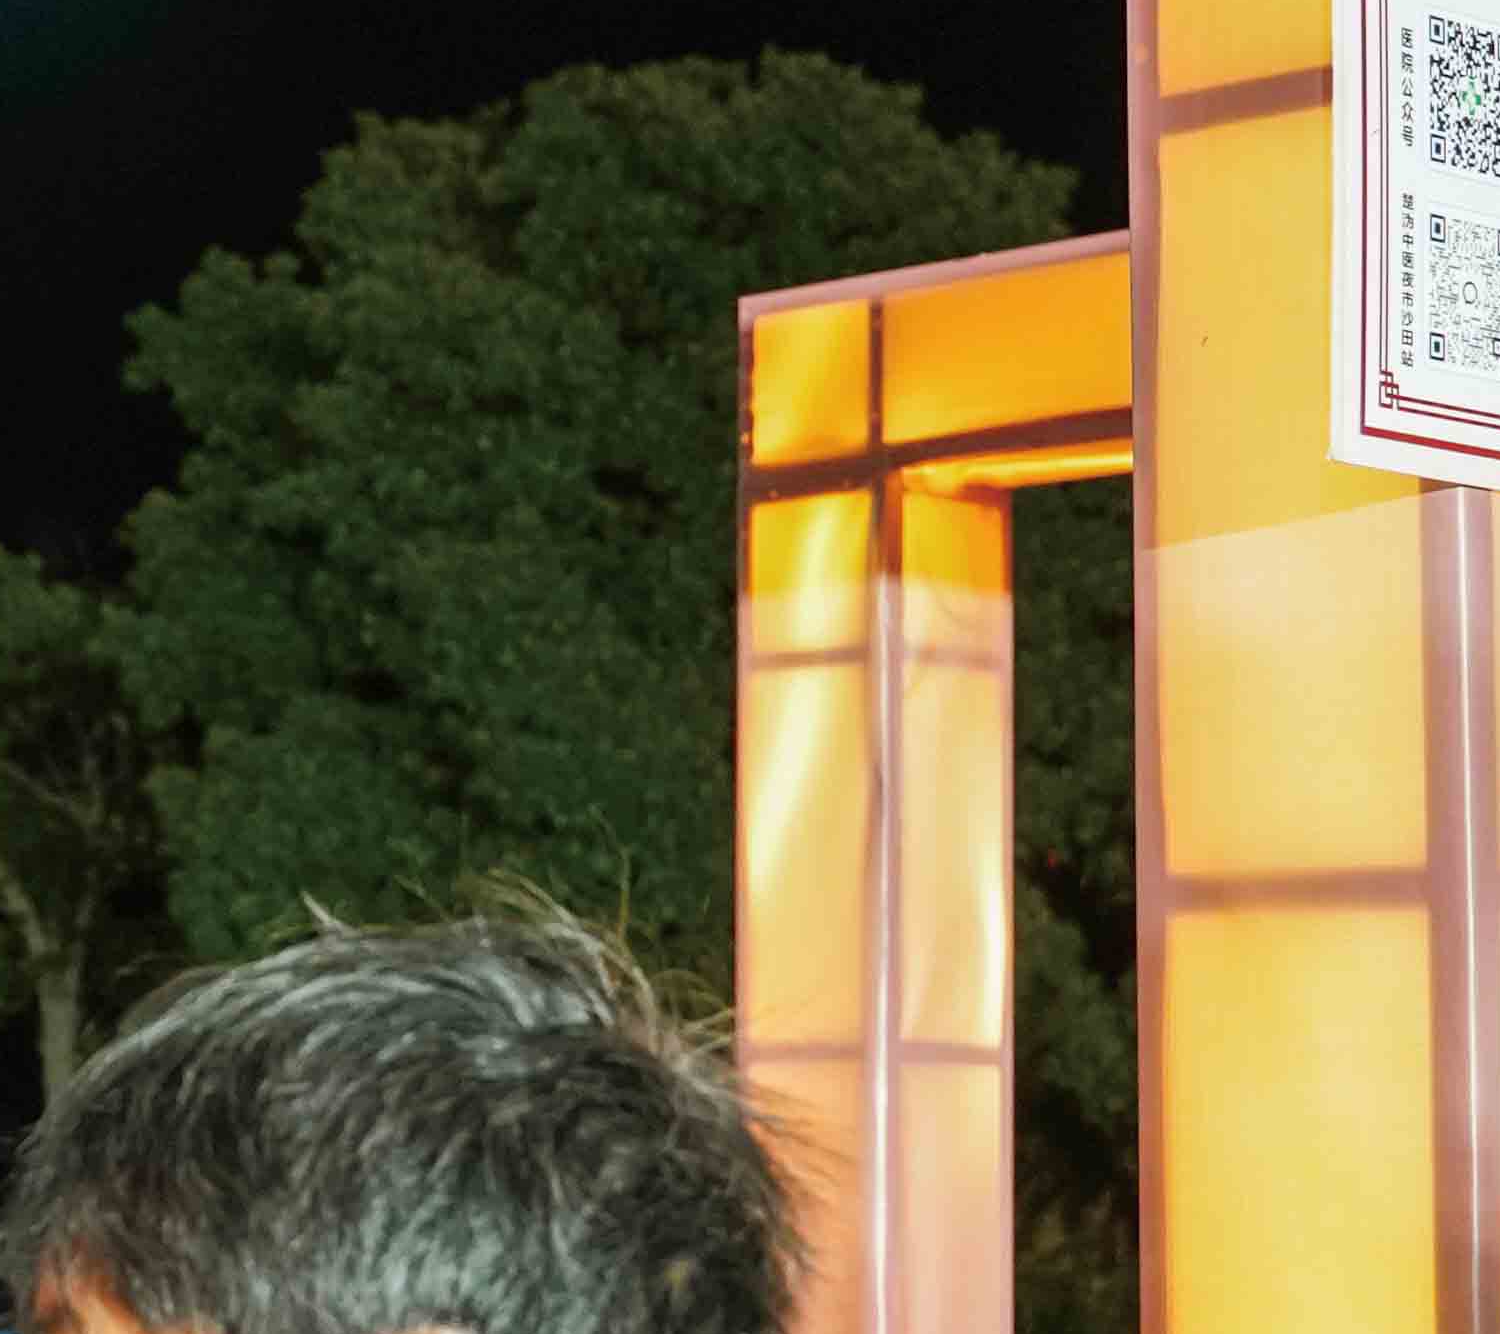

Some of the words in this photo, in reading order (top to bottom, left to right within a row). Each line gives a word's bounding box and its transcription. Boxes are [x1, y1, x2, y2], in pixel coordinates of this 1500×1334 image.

[1400, 27, 1415, 148] 医院公众号
